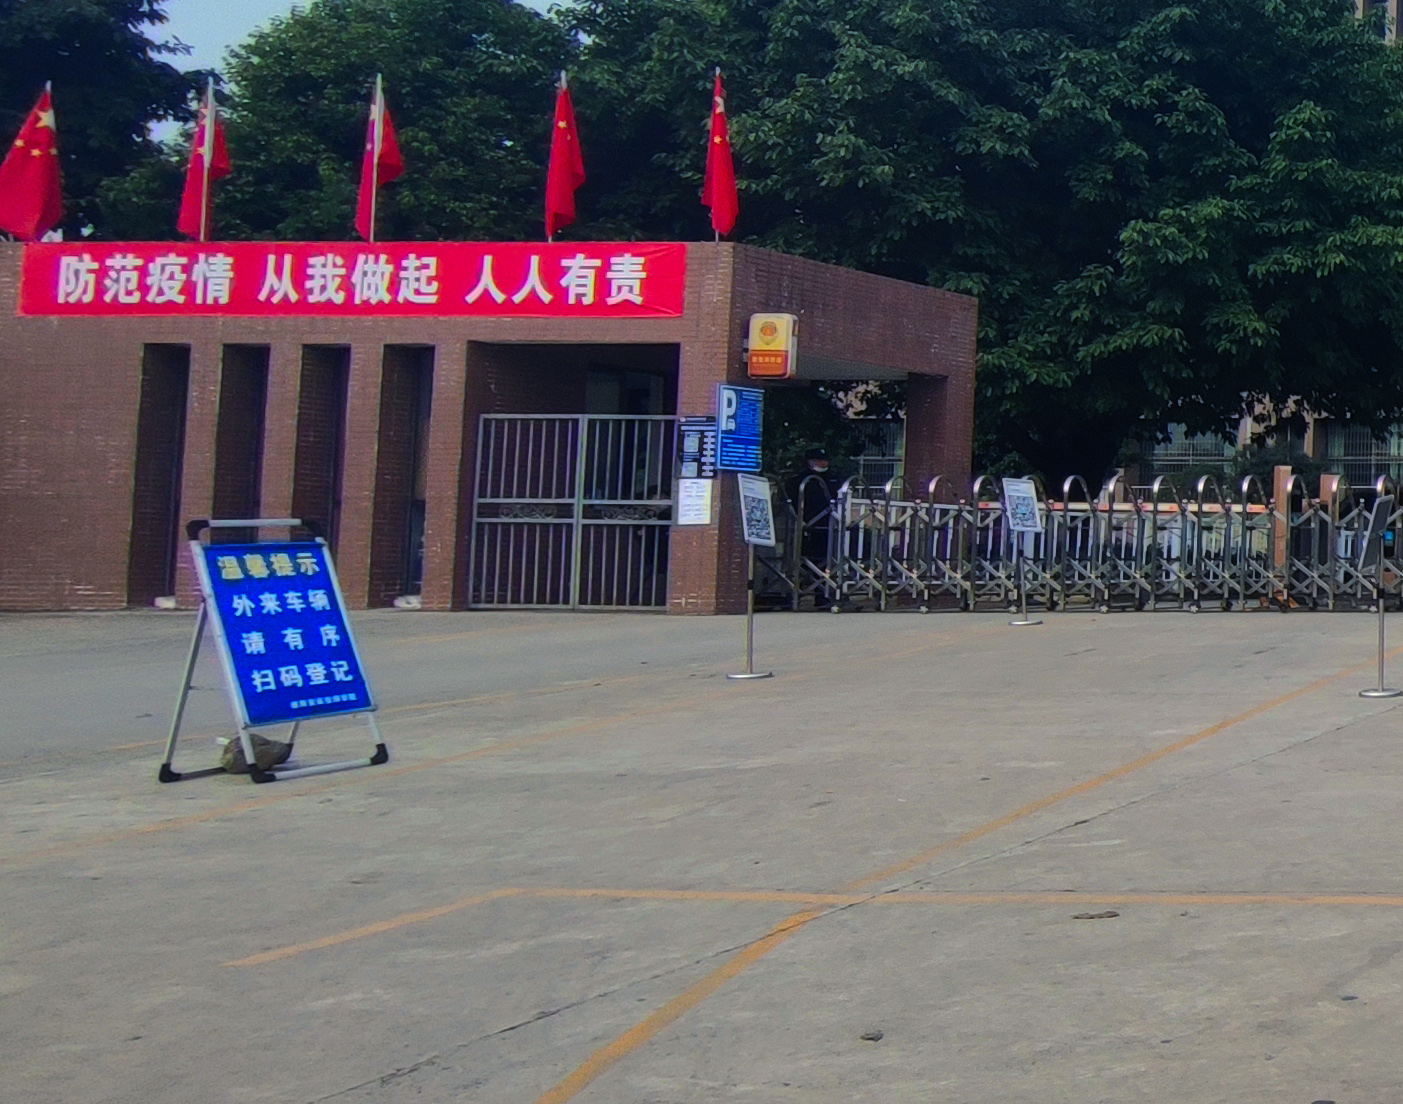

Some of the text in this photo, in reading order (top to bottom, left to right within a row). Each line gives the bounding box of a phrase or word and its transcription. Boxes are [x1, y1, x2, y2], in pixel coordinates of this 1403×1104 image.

[56, 253, 649, 307] 防范疫情 从我做起 人人有责
[217, 553, 320, 579] 温馨提示
[232, 589, 331, 617] 外来车辆
[252, 660, 353, 692] 扫码登记
